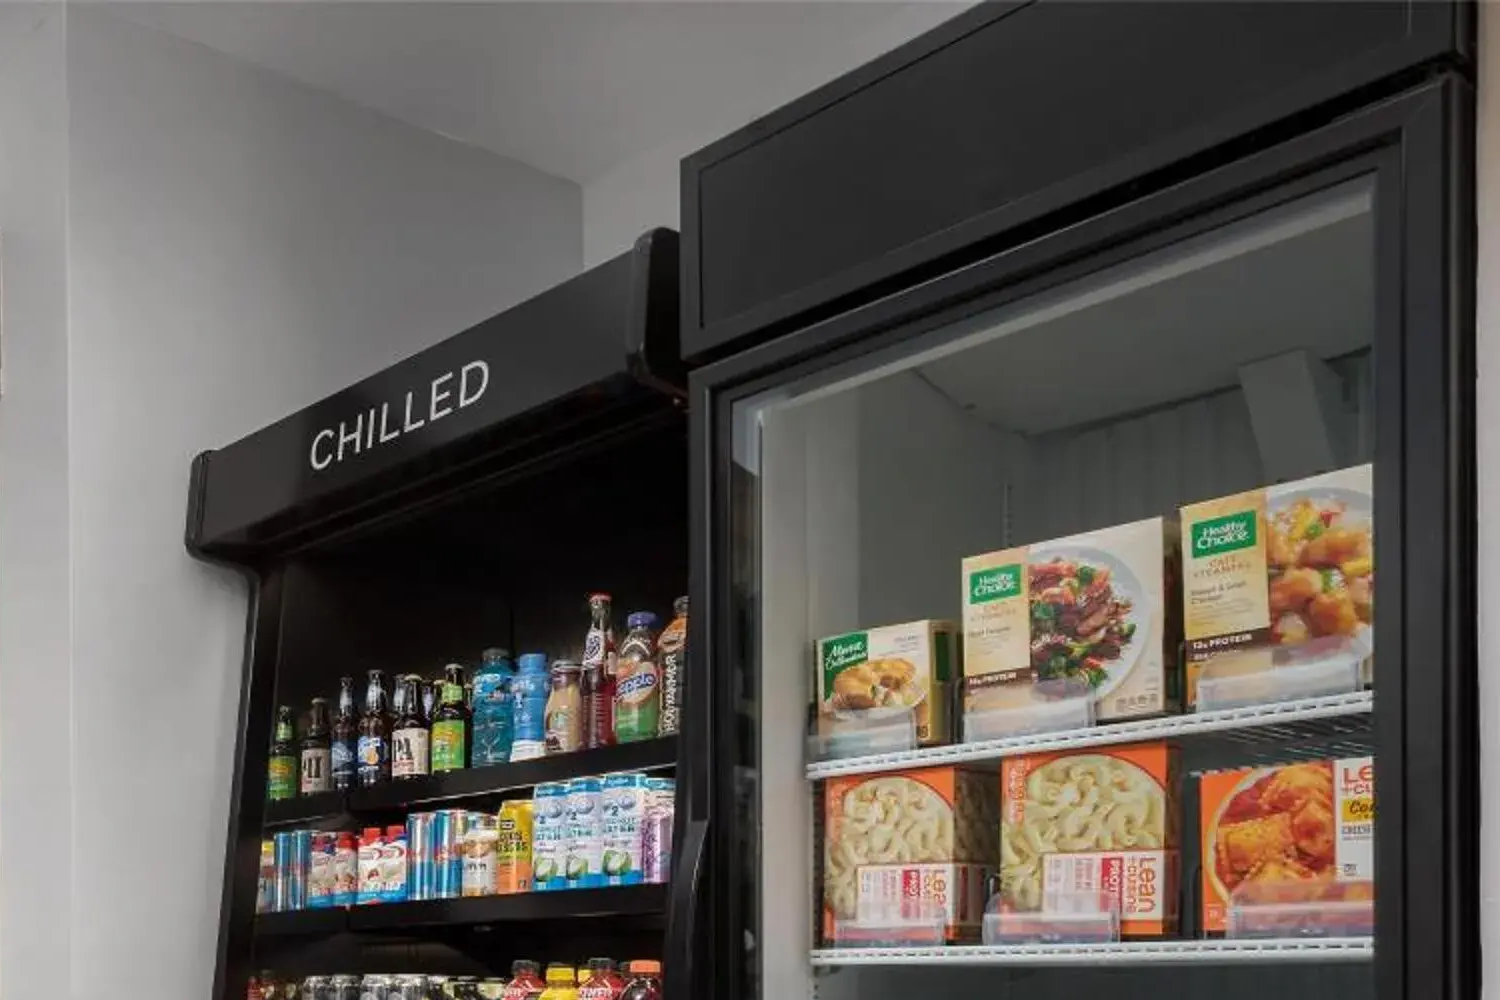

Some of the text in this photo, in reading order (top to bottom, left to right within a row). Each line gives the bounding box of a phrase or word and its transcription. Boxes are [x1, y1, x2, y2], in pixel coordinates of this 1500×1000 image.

[310, 360, 489, 470] CHILLED
[1197, 530, 1250, 549] Choice
[1201, 520, 1248, 538] Healthy
[1139, 856, 1157, 913] Lean
